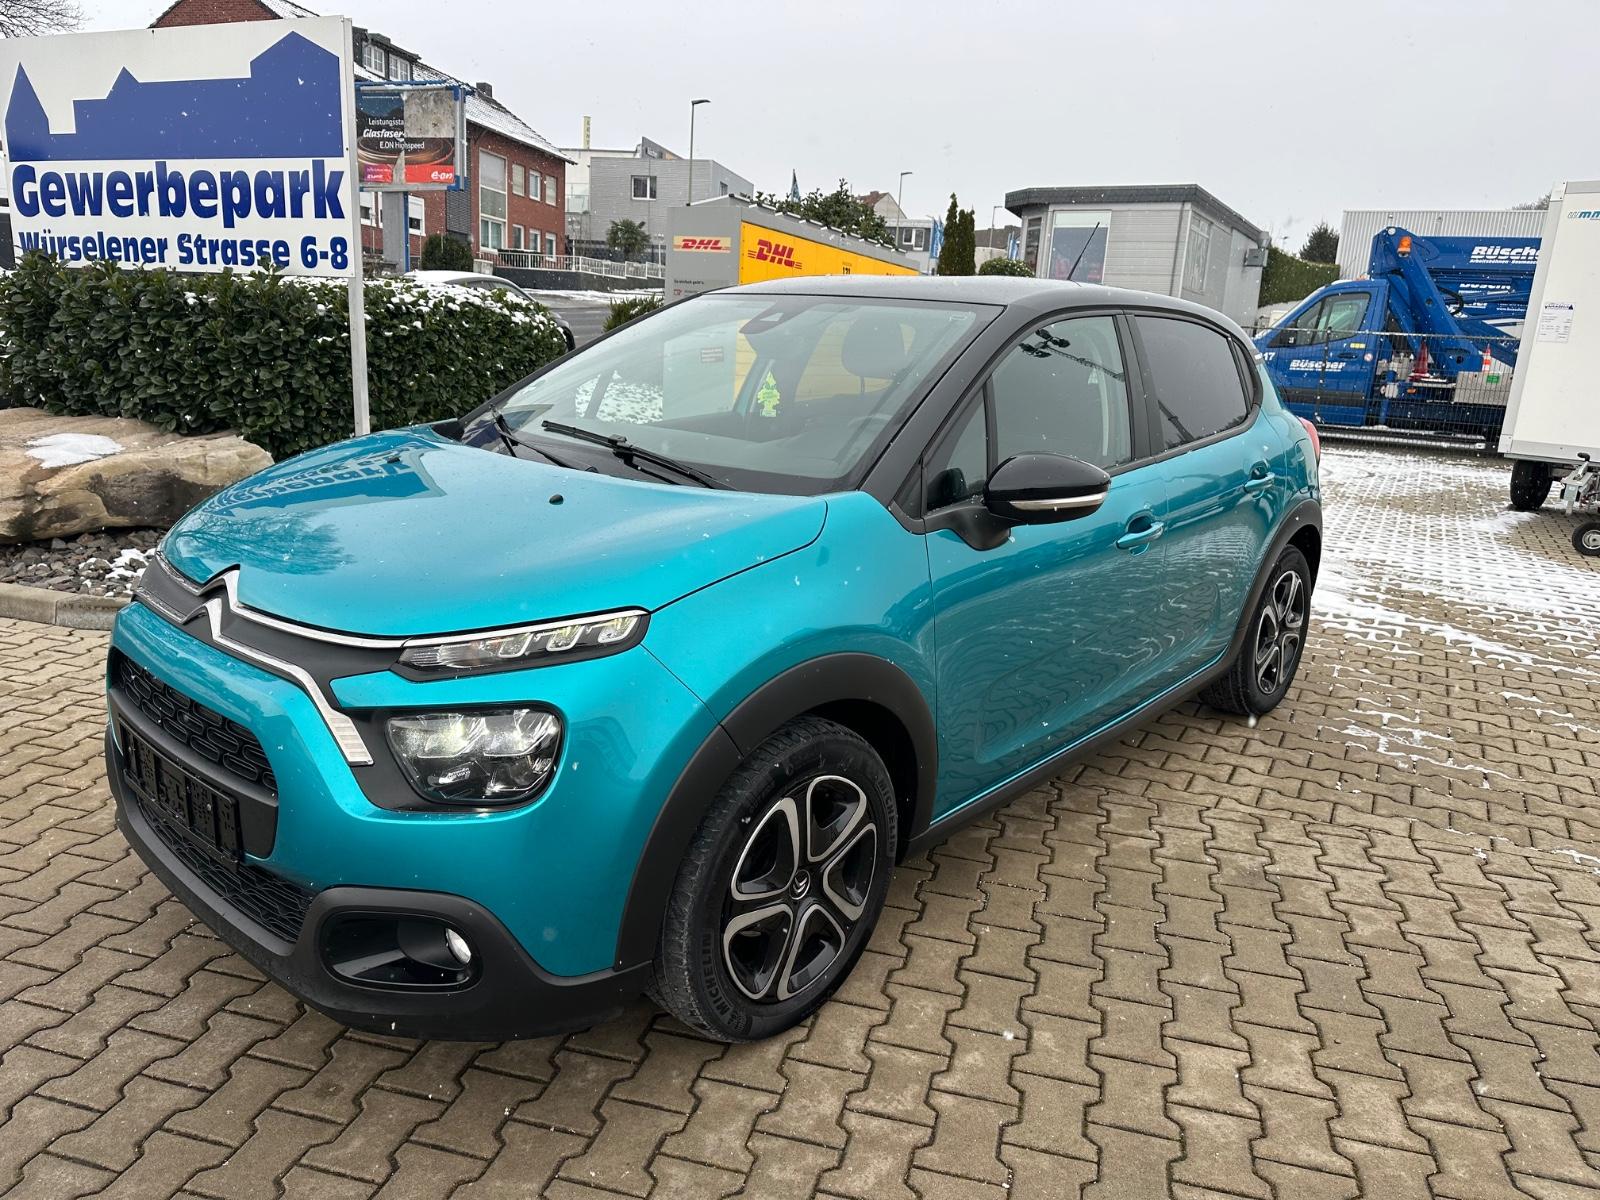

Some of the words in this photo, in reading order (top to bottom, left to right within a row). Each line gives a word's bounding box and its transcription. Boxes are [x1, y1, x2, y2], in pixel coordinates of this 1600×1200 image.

[395, 141, 425, 150] Highspeed
[12, 160, 346, 228] Gewerbepark
[18, 229, 168, 263] Würselener
[177, 233, 290, 267] Strasse
[300, 236, 348, 270] 6-8
[682, 238, 722, 250] DHL
[756, 238, 796, 268] DHL
[701, 932, 731, 1016] MICHELIN
